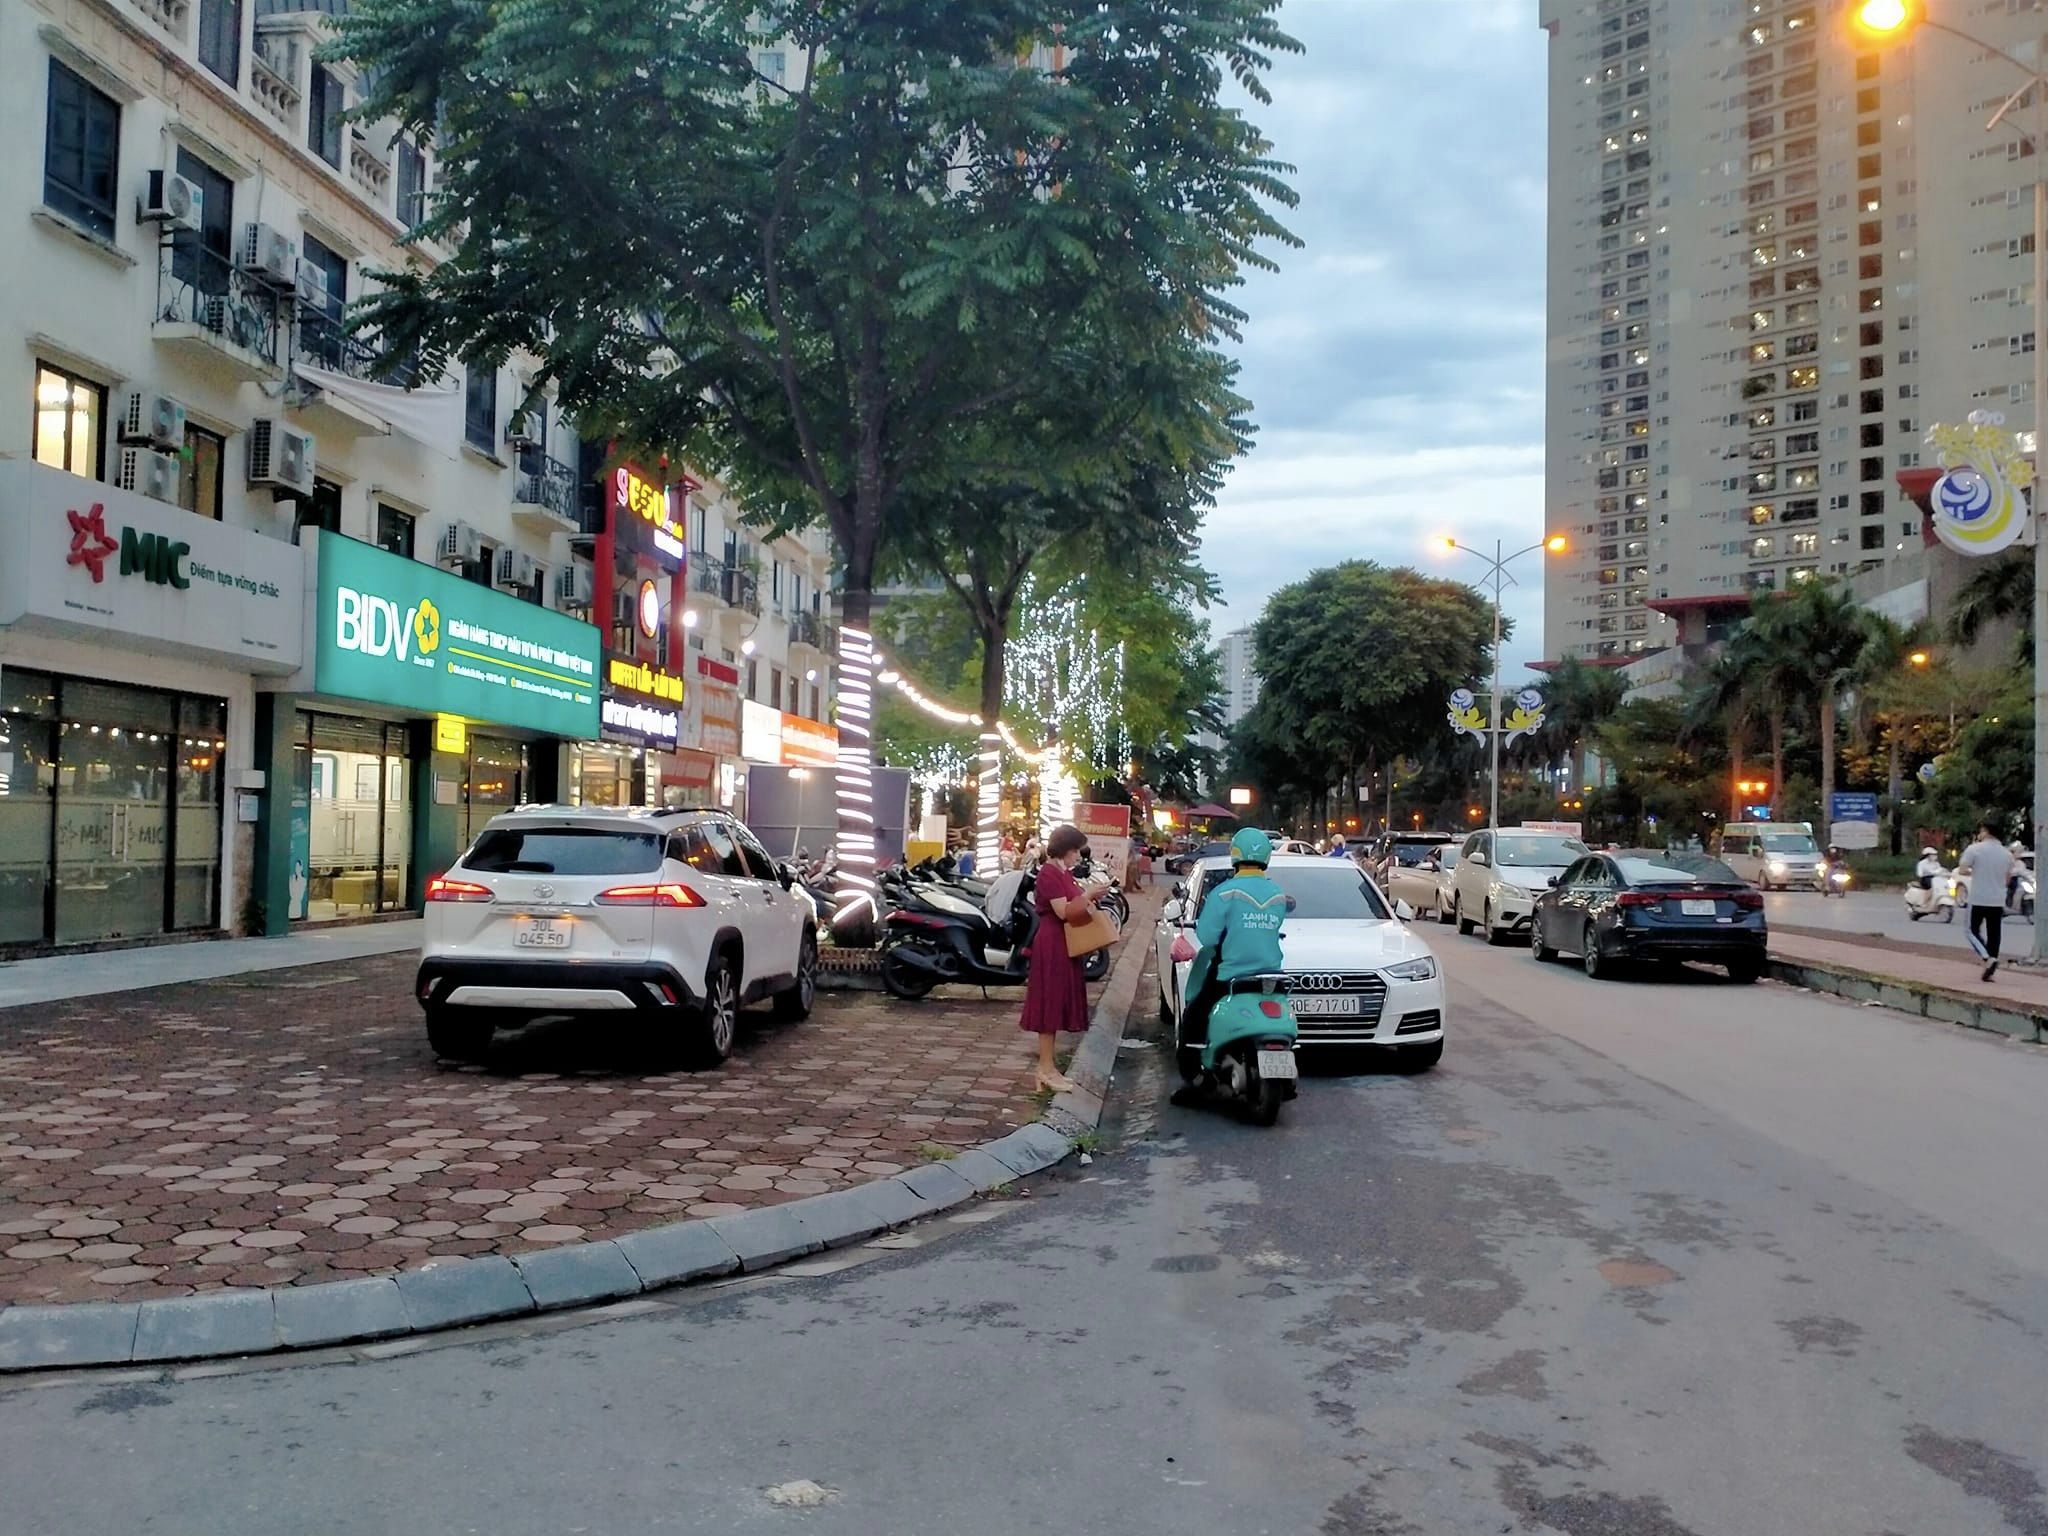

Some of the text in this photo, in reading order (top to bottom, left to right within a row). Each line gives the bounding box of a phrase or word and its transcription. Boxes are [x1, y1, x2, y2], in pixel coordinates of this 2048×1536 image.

[119, 526, 191, 590] MIC
[218, 570, 233, 588] tựa
[336, 586, 418, 662] BIDV
[139, 825, 164, 845] MIC
